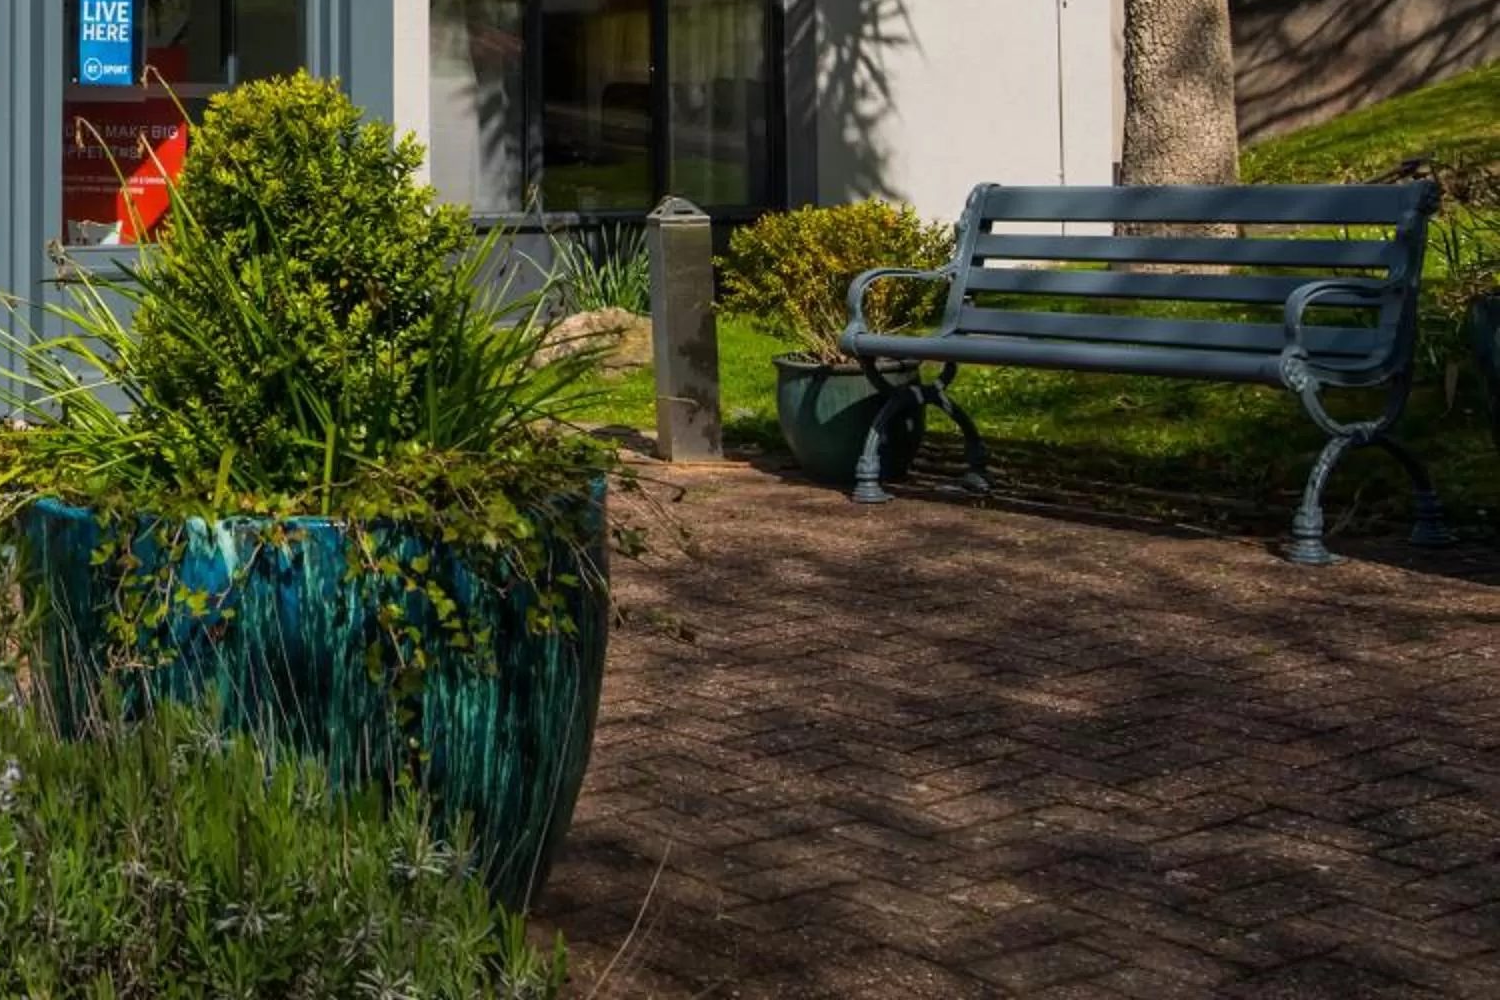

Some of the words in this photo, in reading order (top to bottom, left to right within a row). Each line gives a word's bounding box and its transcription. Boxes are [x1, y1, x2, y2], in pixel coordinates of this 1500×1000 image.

[83, 0, 129, 23] LIVE
[82, 22, 129, 42] HERE
[151, 124, 180, 140] BIG
